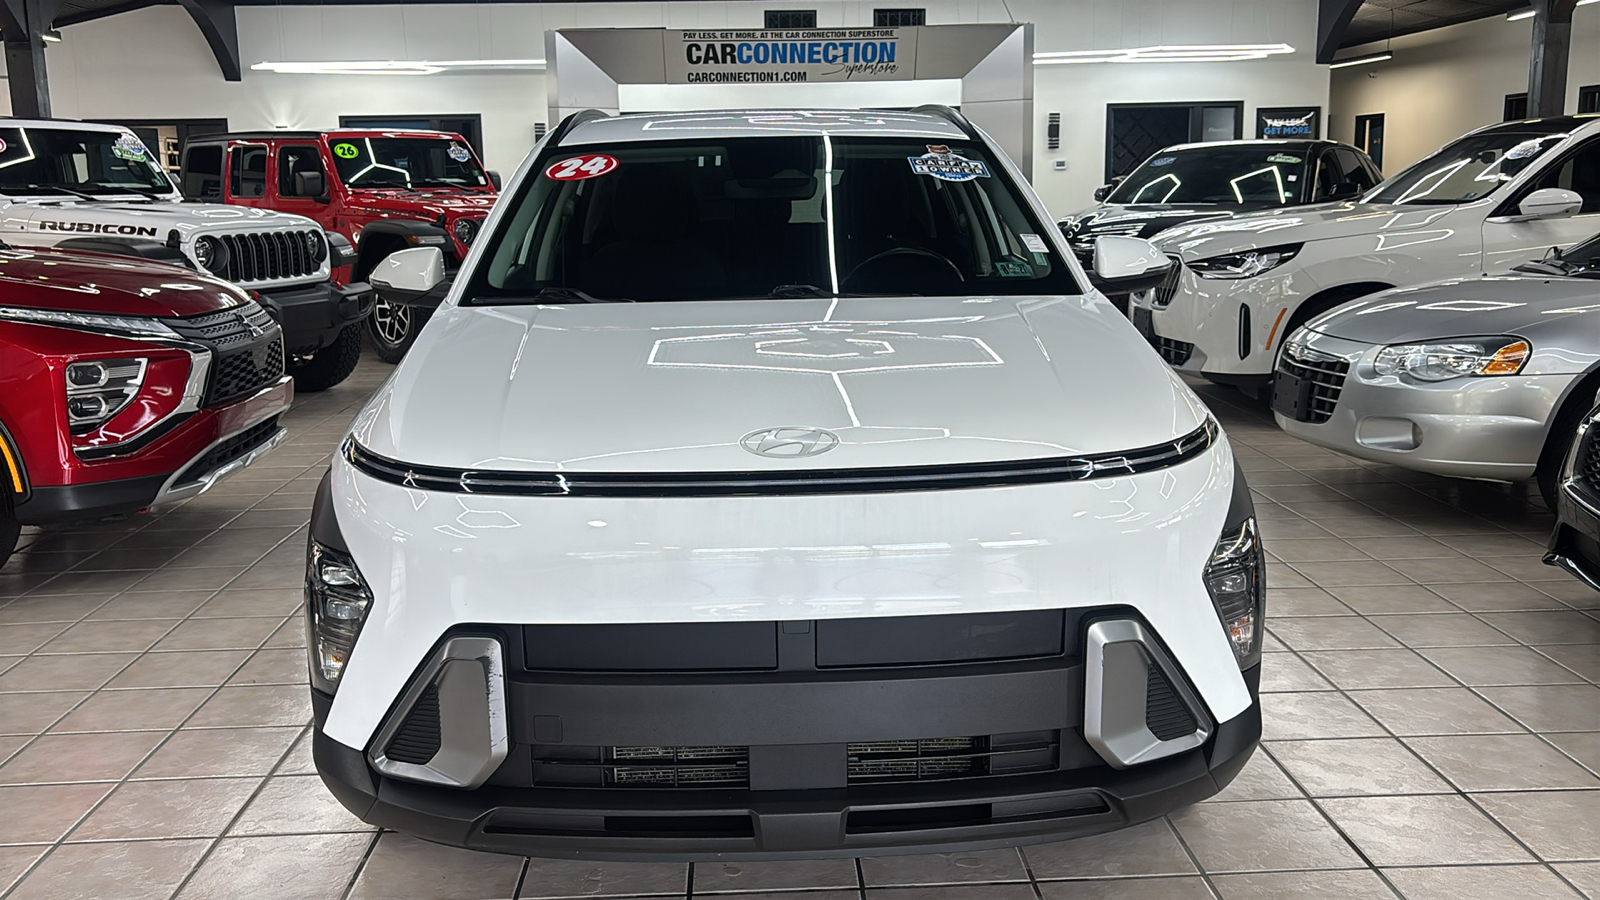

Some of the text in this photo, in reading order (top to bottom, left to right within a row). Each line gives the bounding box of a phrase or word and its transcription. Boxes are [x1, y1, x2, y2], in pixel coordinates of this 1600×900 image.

[770, 31, 784, 39] THE
[785, 31, 800, 39] CAR
[821, 54, 899, 79] Superstore
[687, 72, 807, 82] CARCONNECTION1.COM
[1264, 126, 1312, 135] GET MORE.
[339, 146, 355, 156] 26
[554, 156, 608, 178] 24
[915, 159, 981, 168] CARFAX
[39, 220, 157, 236] RUBICON
